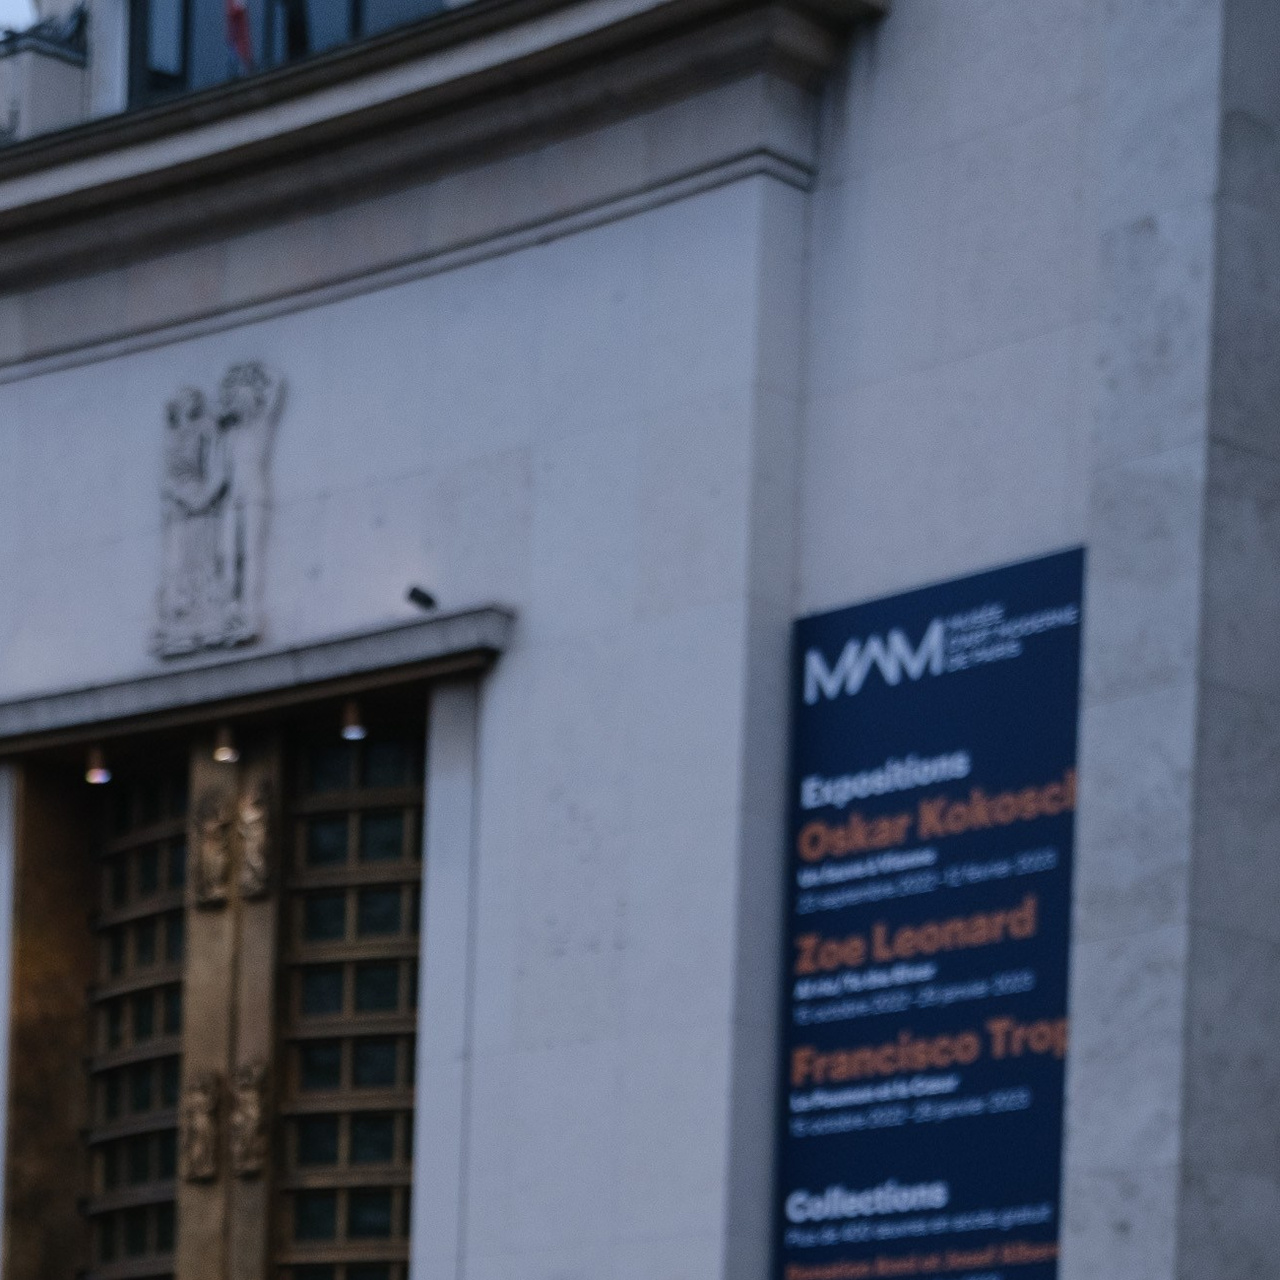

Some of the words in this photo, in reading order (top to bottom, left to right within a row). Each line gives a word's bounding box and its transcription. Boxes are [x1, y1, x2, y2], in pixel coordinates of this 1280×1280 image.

[803, 618, 944, 706] MAM
[801, 750, 971, 809] Expositions
[797, 812, 912, 862] Oskar
[794, 932, 866, 975] Zoe
[872, 895, 1037, 961] Leonard
[791, 1030, 981, 1087] Francisco
[785, 1177, 949, 1223] Collections
